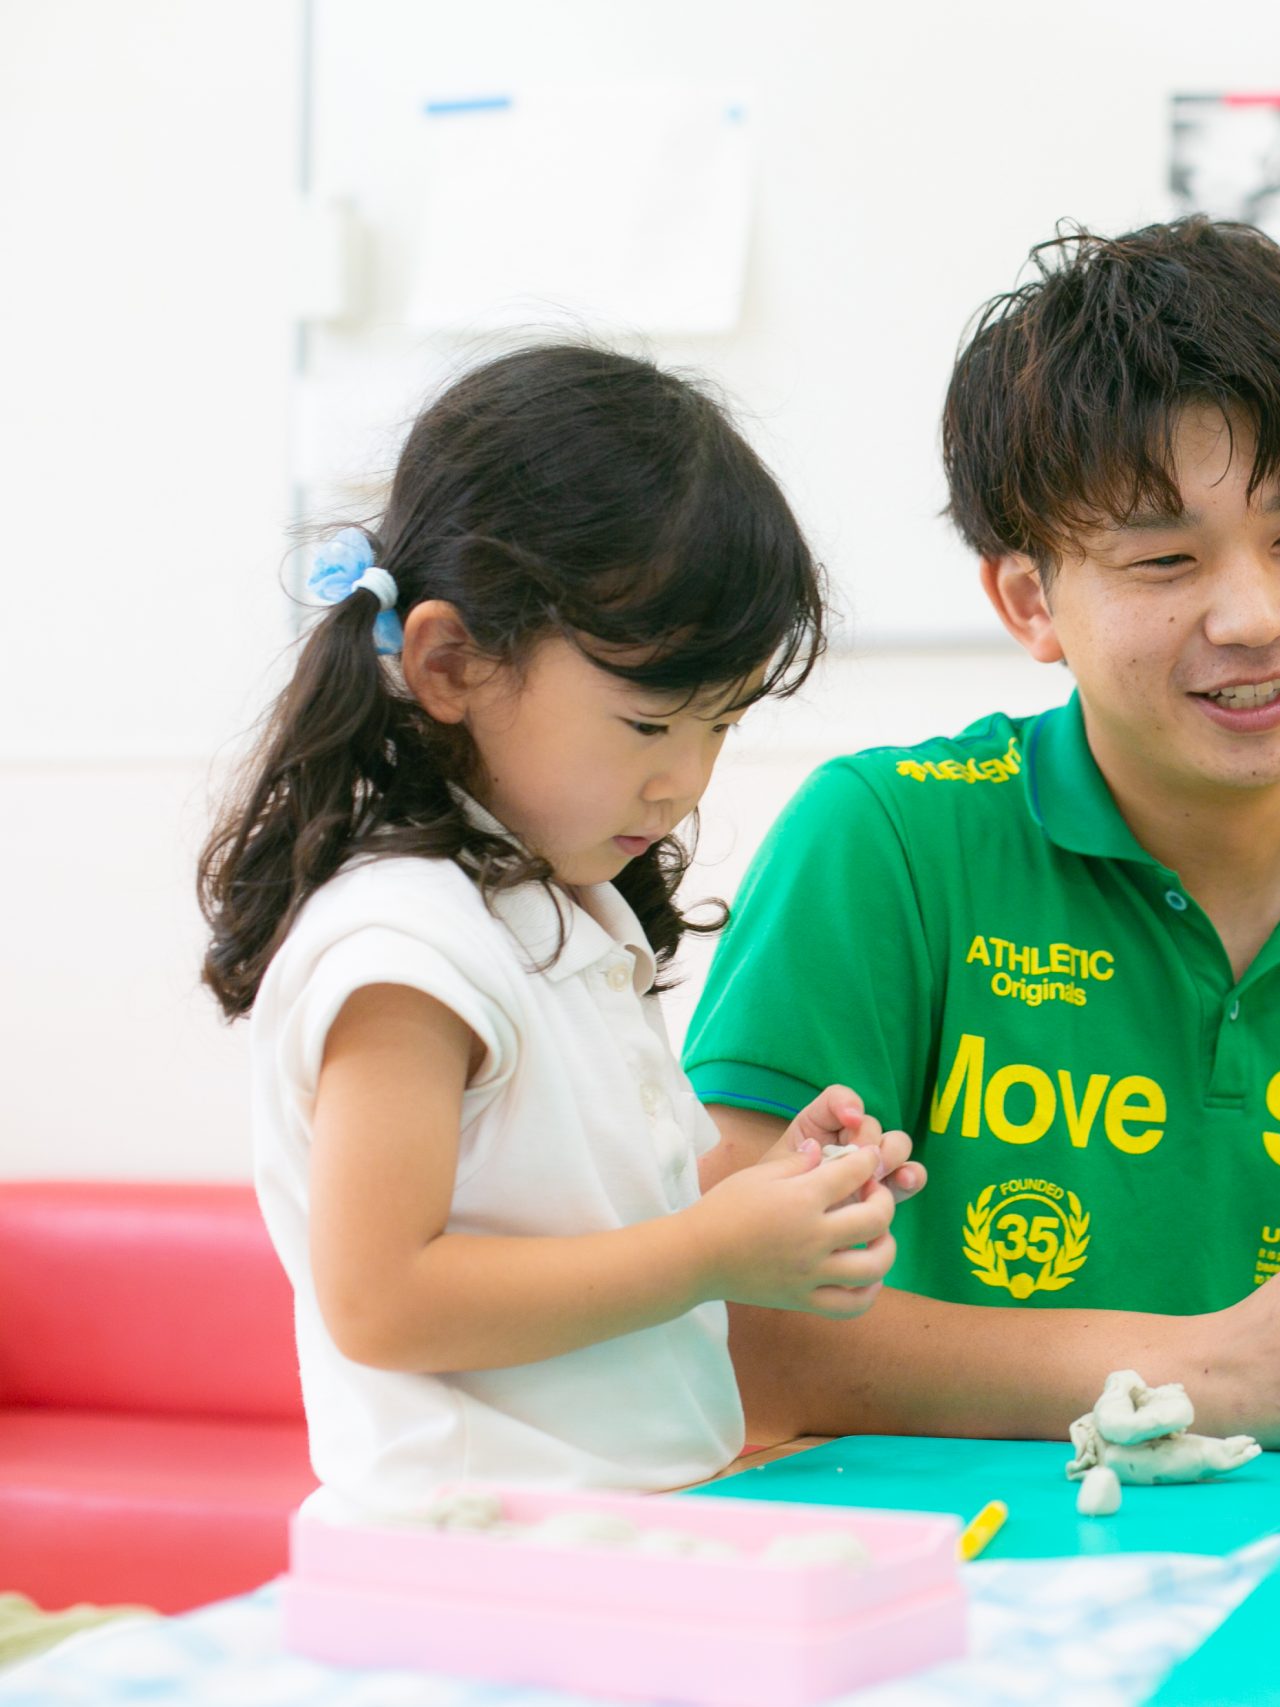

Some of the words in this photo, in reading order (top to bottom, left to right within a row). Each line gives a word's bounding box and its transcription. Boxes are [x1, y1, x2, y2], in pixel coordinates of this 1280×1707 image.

[966, 935, 1115, 981] ATHLETIC
[930, 1033, 1167, 1155] Move
[1000, 1179, 1064, 1200] FOUNDED
[994, 1214, 1059, 1263] 35
